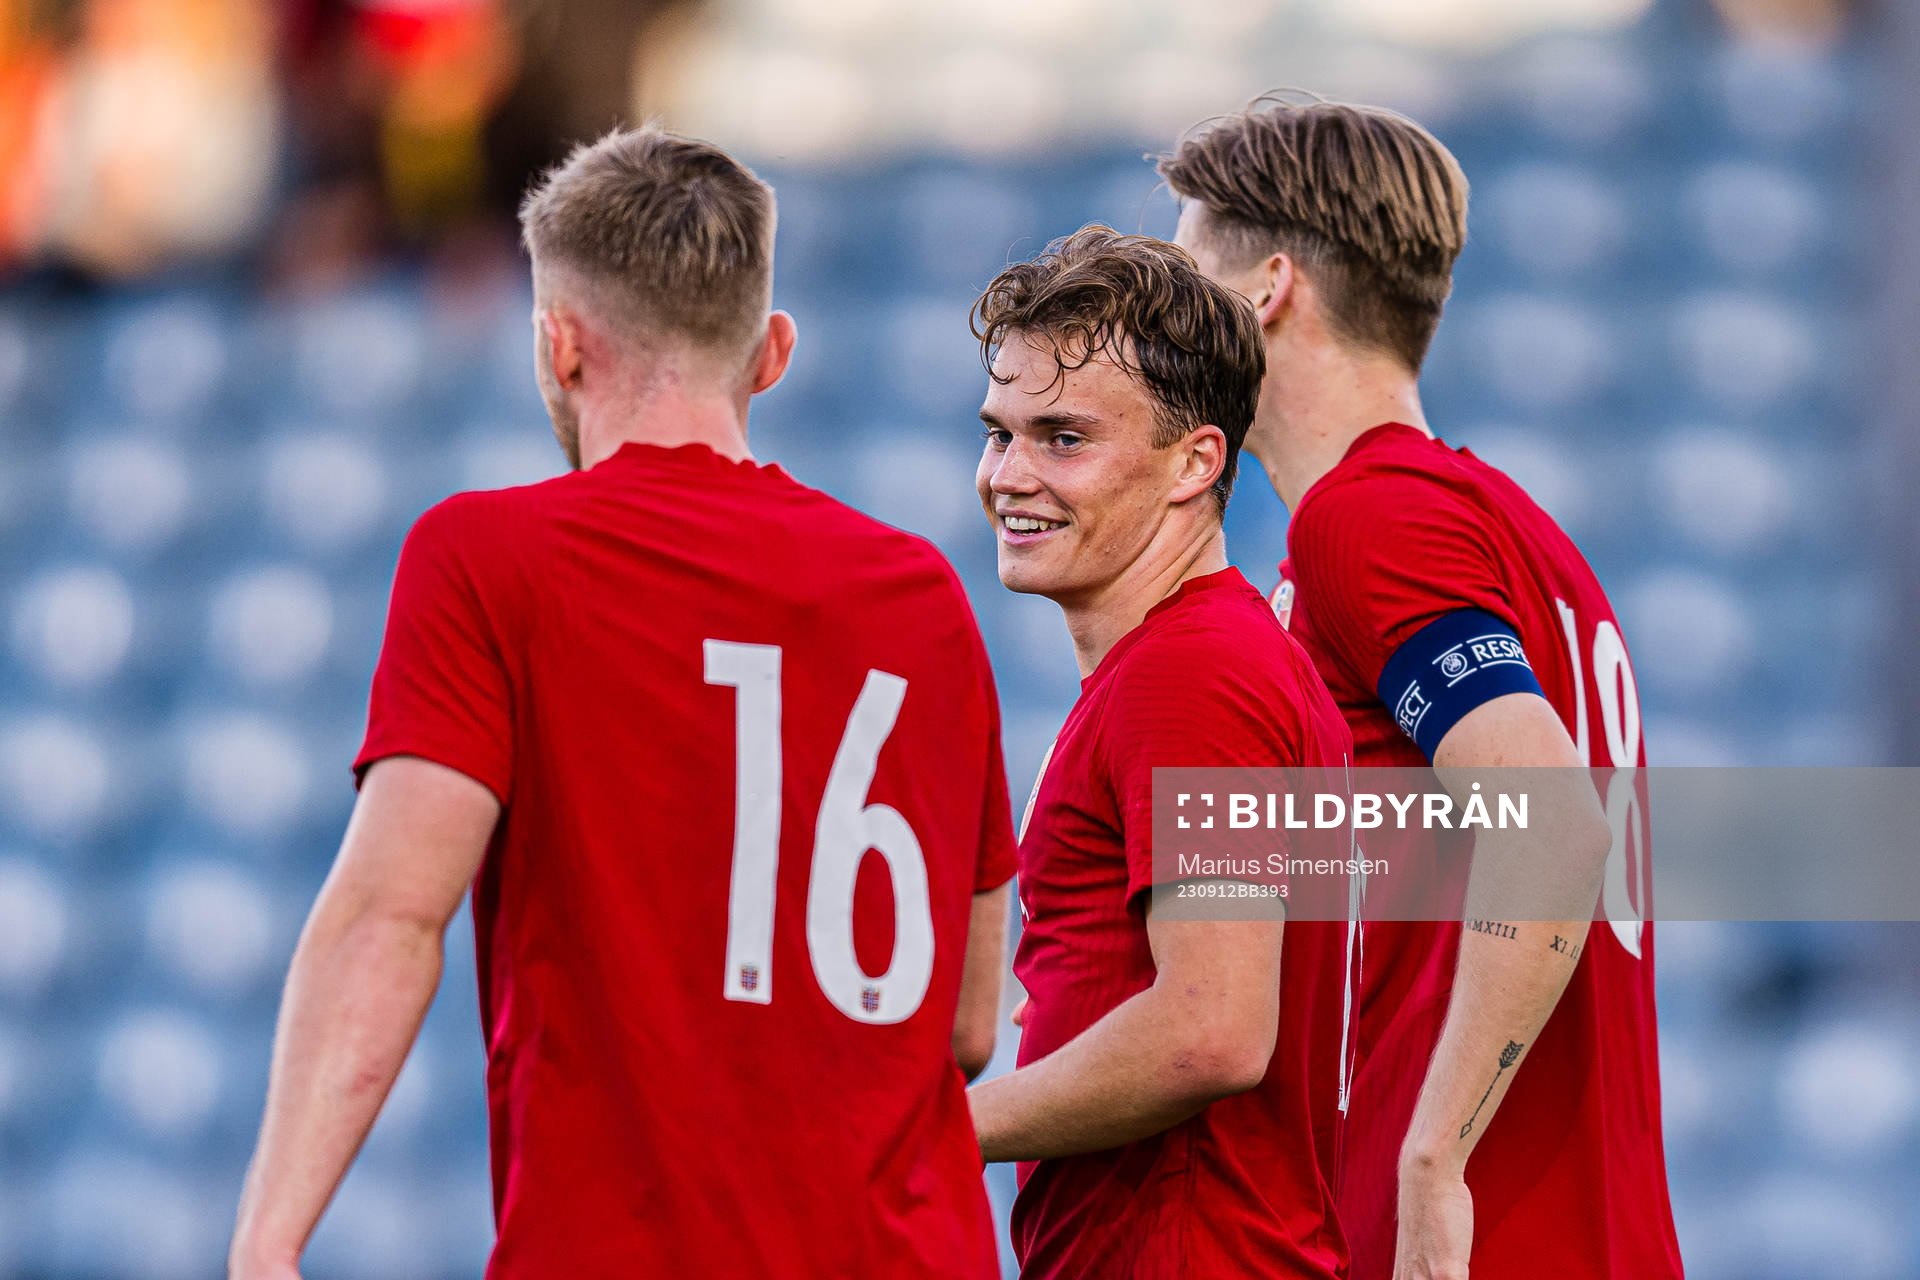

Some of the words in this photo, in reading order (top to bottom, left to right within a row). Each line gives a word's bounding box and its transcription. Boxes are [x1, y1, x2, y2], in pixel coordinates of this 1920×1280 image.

[703, 639, 935, 1024] 16
[1399, 686, 1425, 738] PECT
[1555, 597, 1645, 960] 18
